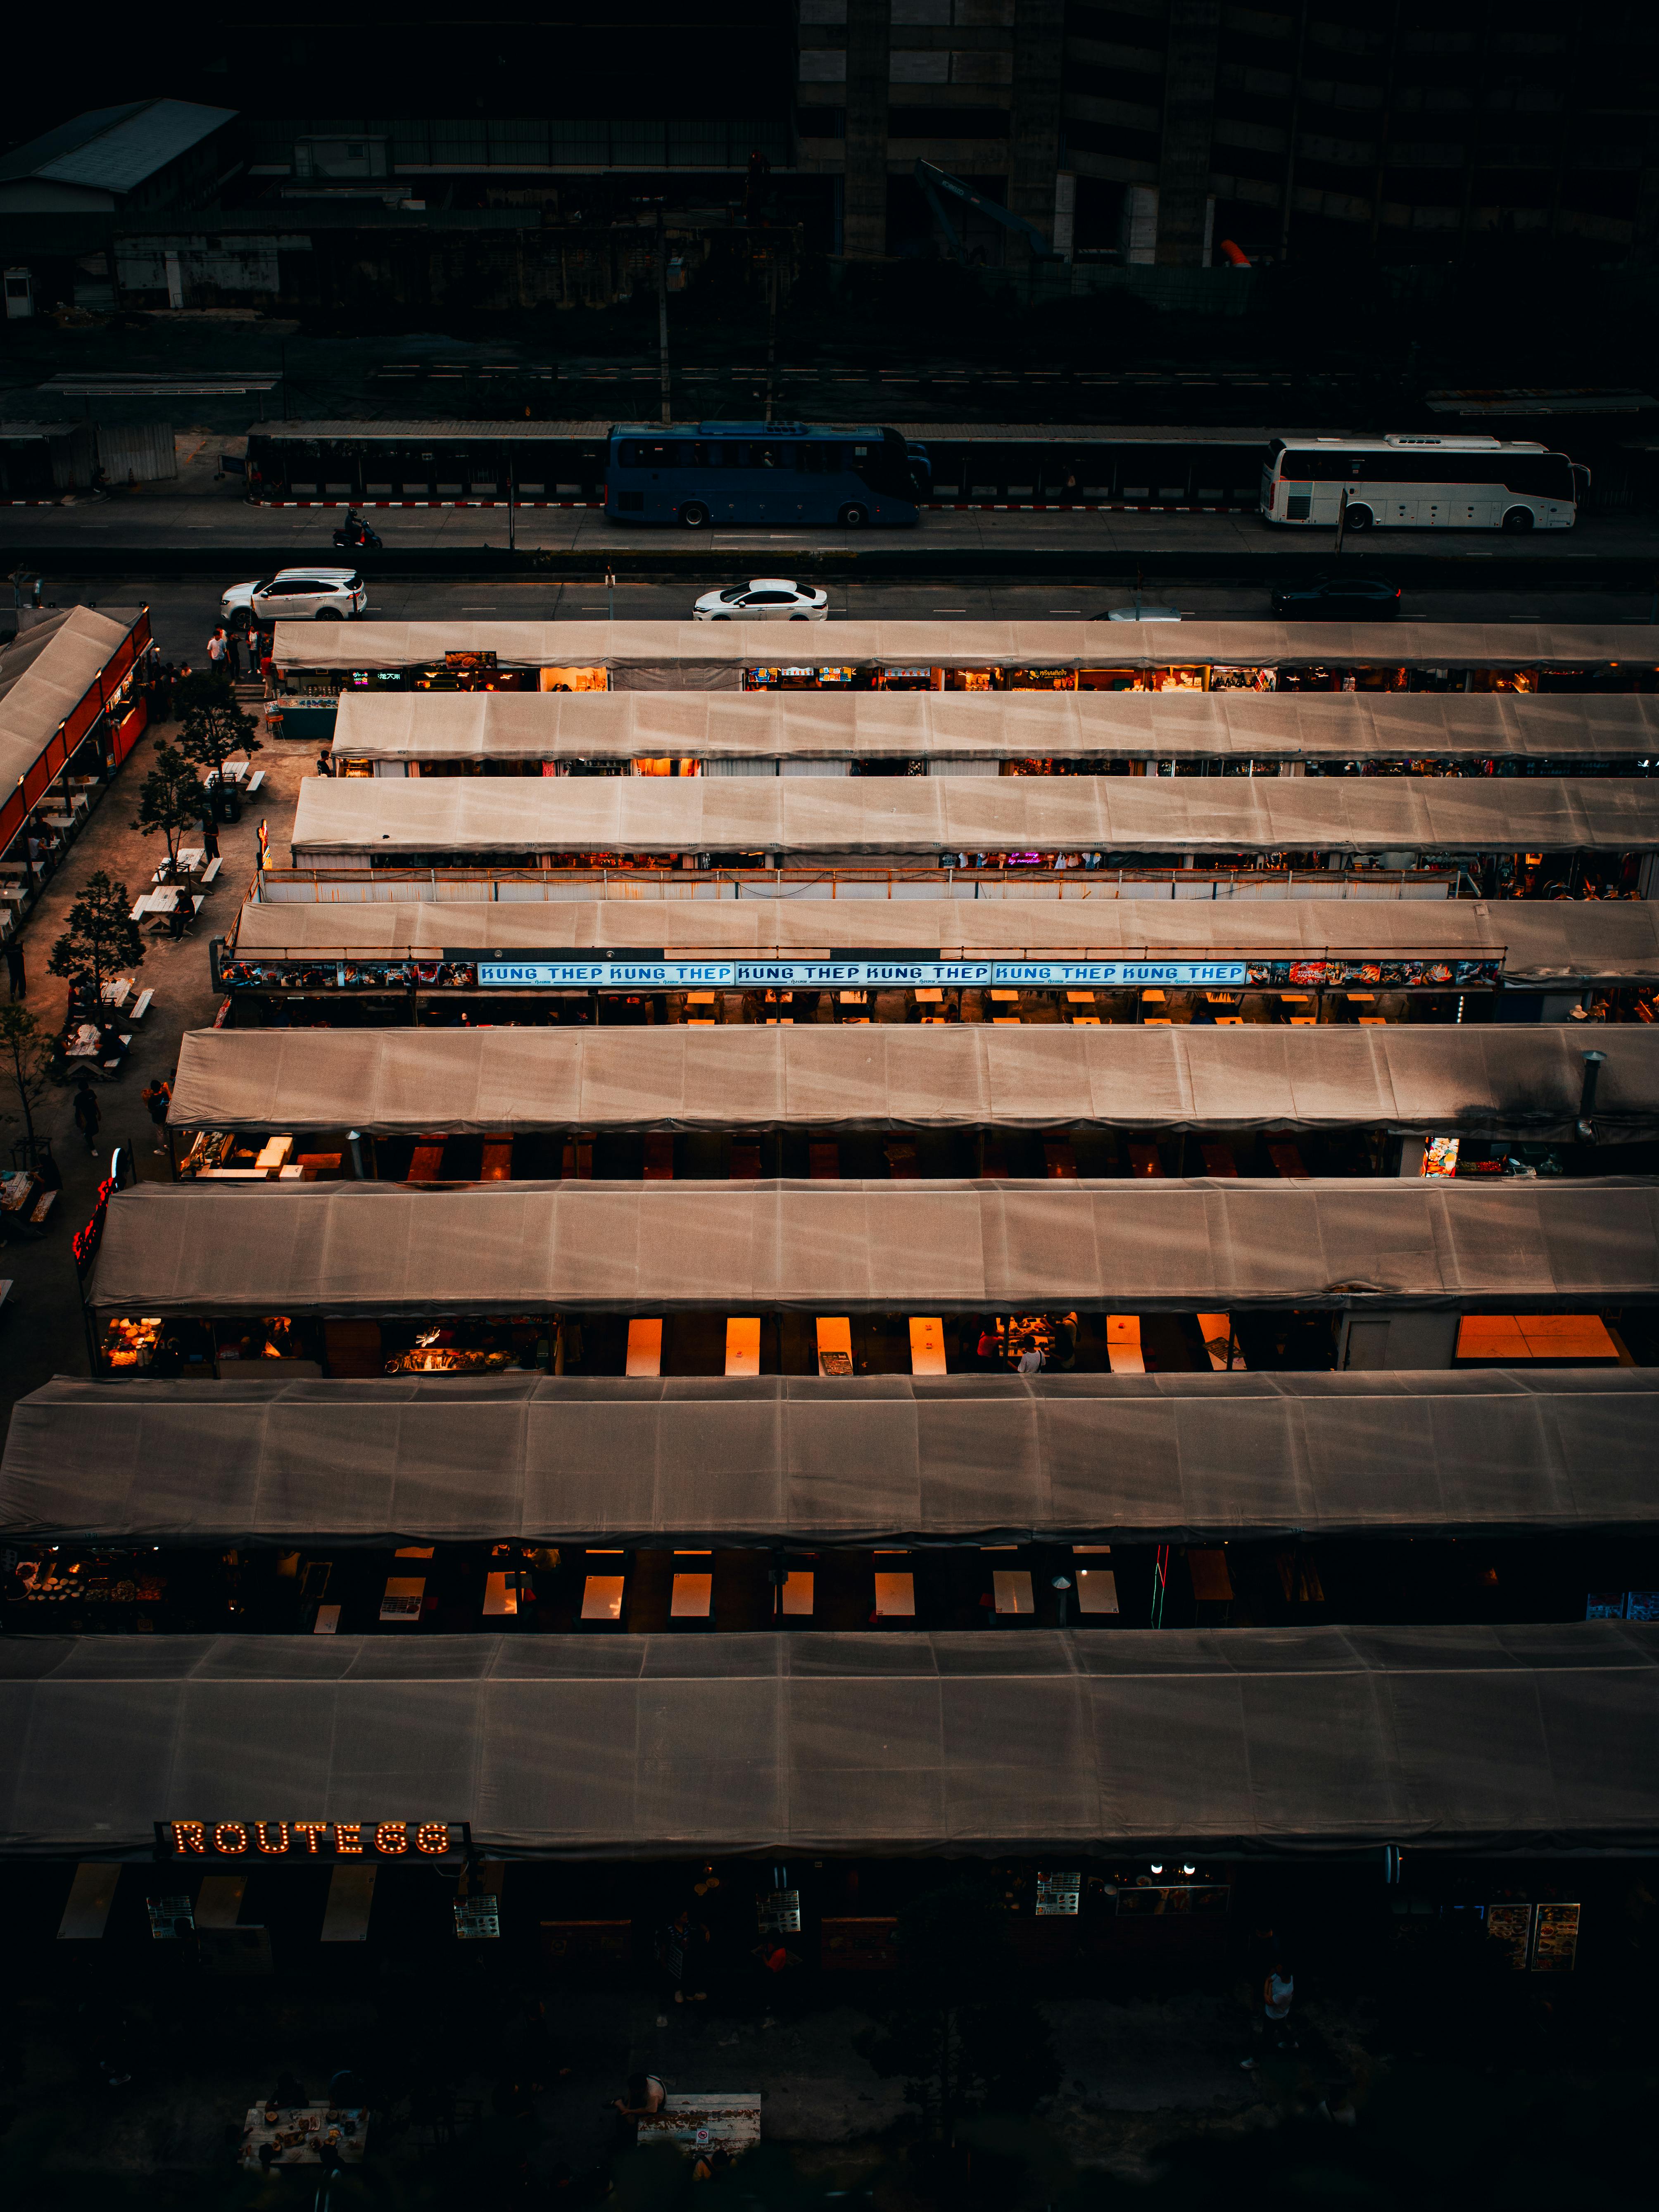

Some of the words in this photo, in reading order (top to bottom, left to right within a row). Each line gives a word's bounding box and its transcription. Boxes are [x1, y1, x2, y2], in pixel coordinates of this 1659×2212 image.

[941, 179, 964, 195] KOBELCO
[482, 968, 537, 979] KUNG
[547, 968, 603, 979] THEP
[611, 968, 665, 979] KUNG
[676, 968, 731, 979] THEP
[739, 968, 793, 979] KUNG
[804, 968, 859, 979] THEP
[867, 968, 922, 979] KUNG
[933, 968, 988, 979] THEP
[996, 968, 1051, 979] KUNG
[1062, 968, 1115, 979] THEP
[1123, 968, 1178, 979] KUNG
[1188, 968, 1243, 979] THEP
[171, 1820, 364, 1858] ROUTE
